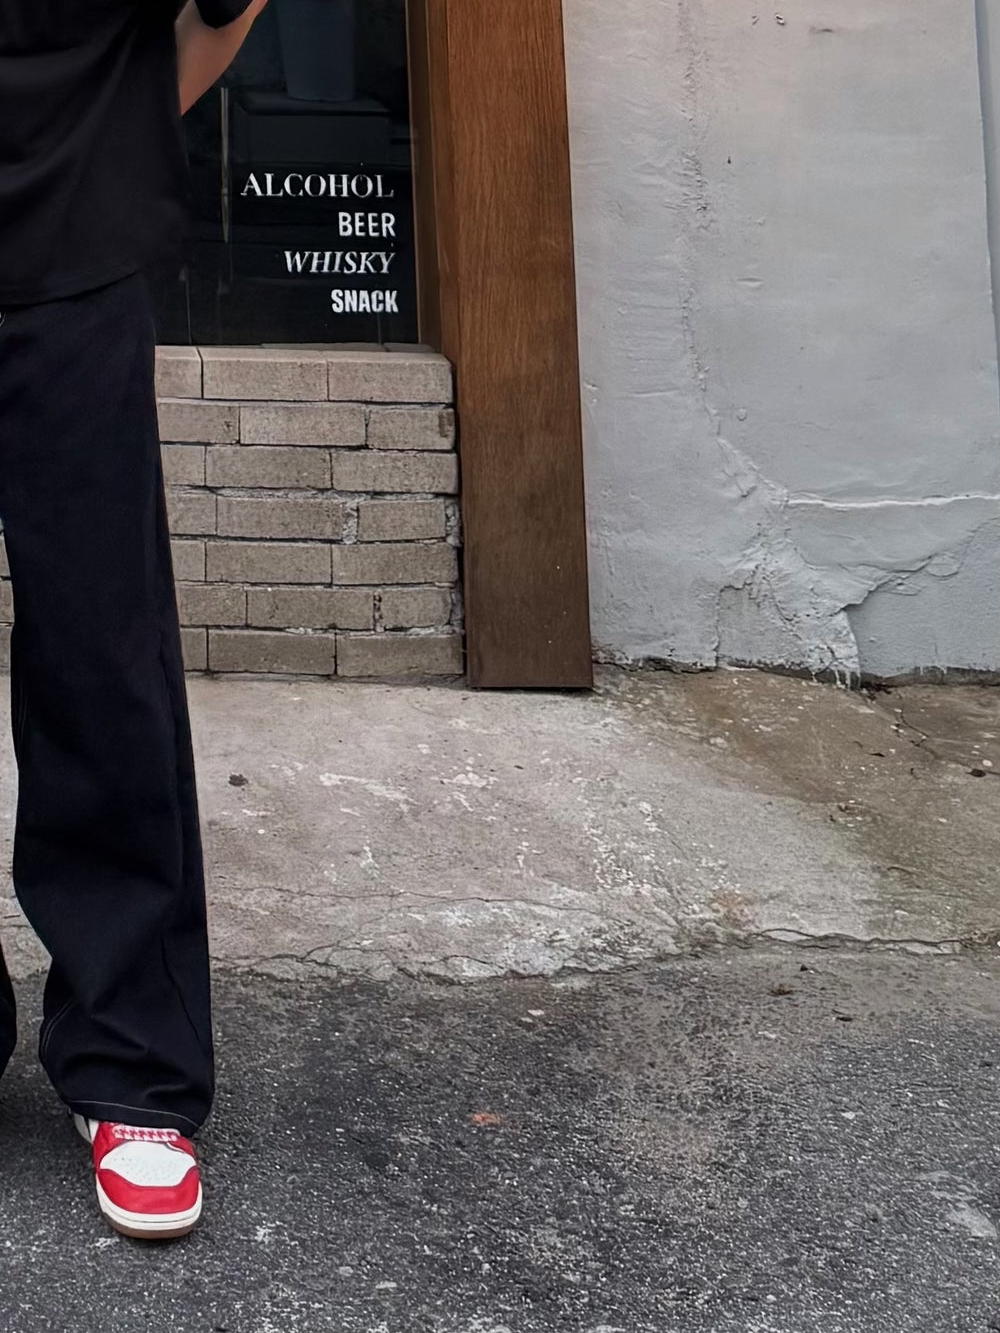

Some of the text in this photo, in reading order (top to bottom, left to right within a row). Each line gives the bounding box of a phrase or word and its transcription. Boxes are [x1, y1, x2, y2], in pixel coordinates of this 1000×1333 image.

[240, 172, 395, 198] ALCOHOL
[338, 212, 396, 238] BEER
[284, 250, 396, 275] WHISKY
[331, 289, 399, 313] SNACK
